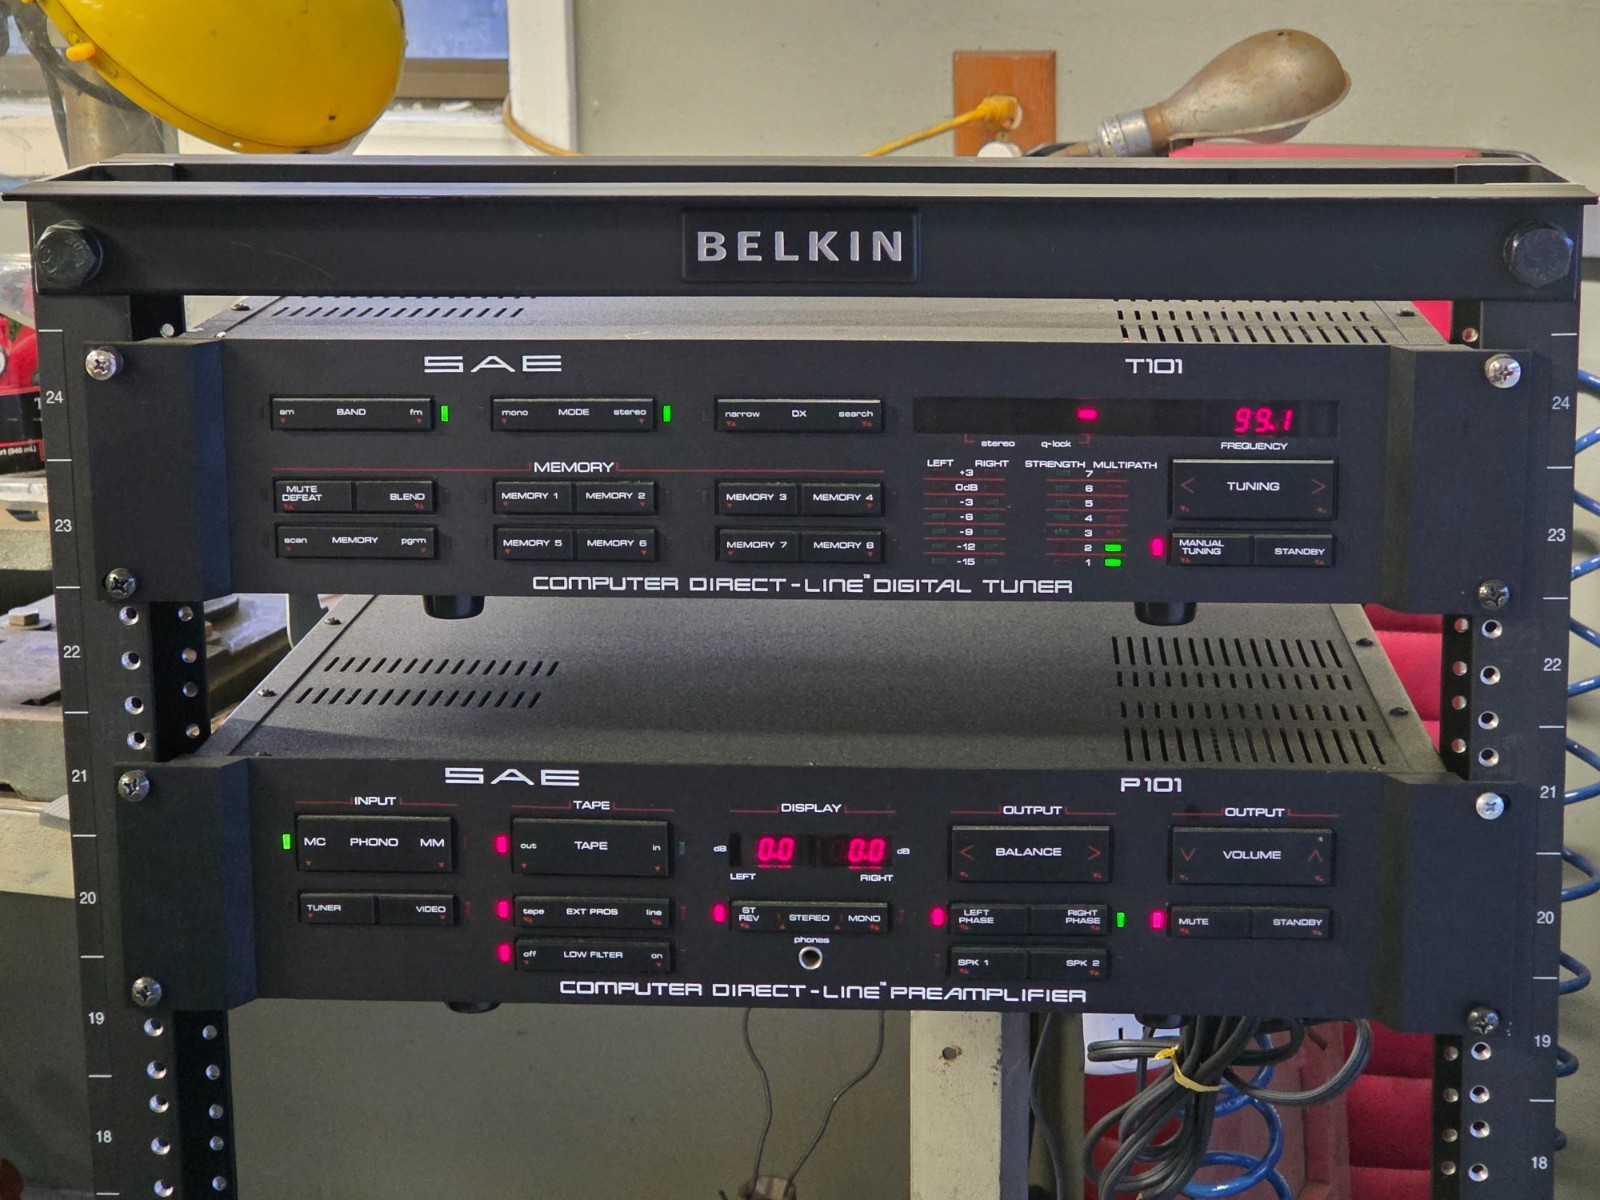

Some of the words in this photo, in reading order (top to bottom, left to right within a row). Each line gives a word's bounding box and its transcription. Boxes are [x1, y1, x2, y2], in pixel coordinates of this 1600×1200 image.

[697, 230, 902, 262] BELKIN
[423, 354, 562, 374] SAE
[1124, 358, 1183, 374] T101
[45, 390, 64, 404] 24
[1551, 395, 1571, 410] 24
[336, 408, 367, 416] BAND
[409, 408, 423, 416] fm
[558, 408, 590, 416] MODE
[613, 408, 647, 416] stereo
[791, 409, 807, 418] DX
[838, 410, 874, 418] search
[1233, 408, 1294, 432] 99.1
[1040, 439, 1072, 449] q-lock
[1220, 441, 1288, 451] FREQUENCY
[533, 461, 615, 473] MEMORY
[926, 458, 955, 467] LEFT
[974, 459, 1010, 468] RIGHT
[1024, 459, 1086, 469] STRENGTH
[1092, 460, 1158, 470] MULTIPATH
[959, 468, 974, 477] +3
[1085, 469, 1094, 478] 7
[286, 485, 318, 493] MUTE
[1085, 484, 1094, 493] 6
[1226, 481, 1280, 492] TUNING
[281, 493, 323, 502] DEFEAT
[389, 492, 426, 501] BLEND
[501, 491, 549, 500] MEMORY
[553, 492, 559, 500] 1
[585, 491, 634, 500] MEMORY
[637, 492, 646, 500] 2
[726, 493, 775, 501] MEMORY
[779, 493, 787, 501] 3
[812, 493, 862, 502] MEMORY
[865, 493, 874, 501] 4
[959, 498, 974, 507] -3
[1084, 499, 1094, 508] 5
[959, 512, 974, 521] -6
[1084, 514, 1093, 522] 4
[54, 518, 73, 533] 23
[959, 528, 974, 536] -9
[1084, 529, 1093, 538] 3
[1547, 527, 1566, 543] 23
[331, 536, 379, 544] MEMORY
[400, 537, 427, 546] pgrm
[502, 539, 551, 547] MEMORY
[554, 539, 563, 547] 5
[586, 539, 635, 547] MEMORY
[638, 539, 647, 547] 6
[1179, 539, 1225, 547] MANUAL
[726, 541, 775, 549] MEMORY
[779, 541, 788, 549] 7
[813, 541, 862, 550] MEMORY
[866, 541, 875, 550] 8
[956, 542, 976, 551] -12
[1083, 544, 1093, 552] 2
[1181, 547, 1222, 556] TUNING
[1274, 547, 1326, 556] STANDBY
[956, 557, 976, 566] -15
[1085, 558, 1091, 567] 1
[532, 576, 679, 591] COMPUTER
[873, 578, 972, 594] DIGITAL
[982, 579, 1073, 594] TUNER
[63, 644, 81, 659] 22
[1543, 657, 1562, 672] 22
[71, 769, 87, 783] 21
[444, 767, 580, 787] SAE
[1120, 777, 1182, 793] P101
[1539, 785, 1556, 799] 21
[354, 796, 397, 806] INPUT
[572, 800, 611, 811] TAPE
[780, 803, 842, 813] DISPLAY
[1002, 805, 1063, 816] OUTPUT
[1224, 807, 1286, 818] OUTPUT
[303, 837, 327, 847] MC
[349, 837, 399, 847] PHONO
[419, 838, 445, 847] MM
[520, 842, 537, 850] out
[573, 840, 608, 851] TAPE
[713, 845, 727, 853] dB
[758, 838, 795, 861] 0.0
[848, 839, 885, 863] 0.0
[896, 847, 911, 855] dB
[995, 847, 1062, 857] BALANCE
[1222, 850, 1282, 860] VOLUME
[729, 872, 757, 881] LEFT
[859, 874, 894, 882] RIGHT
[79, 891, 97, 905] 20
[306, 904, 342, 912] TUNER
[415, 905, 447, 913] VIDEO
[522, 908, 545, 916] tape
[566, 907, 587, 915] EXT
[589, 908, 619, 916] PROS
[645, 908, 663, 916] line
[742, 906, 757, 914] ST
[788, 913, 830, 922] STEREO
[963, 909, 990, 917] LEFT
[1067, 909, 1098, 917] RIGHT
[1536, 910, 1555, 925] 20
[738, 914, 760, 922] REV
[847, 914, 881, 923] MONO
[958, 916, 994, 924] PHASE
[1065, 917, 1101, 925] PHASE
[1178, 917, 1209, 926] MUTE
[1272, 918, 1323, 927] STANDBY
[793, 936, 830, 944] phones
[522, 950, 537, 958] off
[563, 950, 588, 958] LOW
[589, 950, 624, 959] FILTER
[957, 958, 980, 967] SPK
[1065, 959, 1088, 967] SPK
[1091, 959, 1100, 967] 2
[559, 980, 703, 997] COMPUTER
[890, 986, 1087, 1003] PREAMPLIFIER
[88, 1011, 105, 1025] 19
[1534, 1034, 1552, 1048] 19
[96, 1129, 113, 1144] 18
[1531, 1155, 1548, 1170] 18
